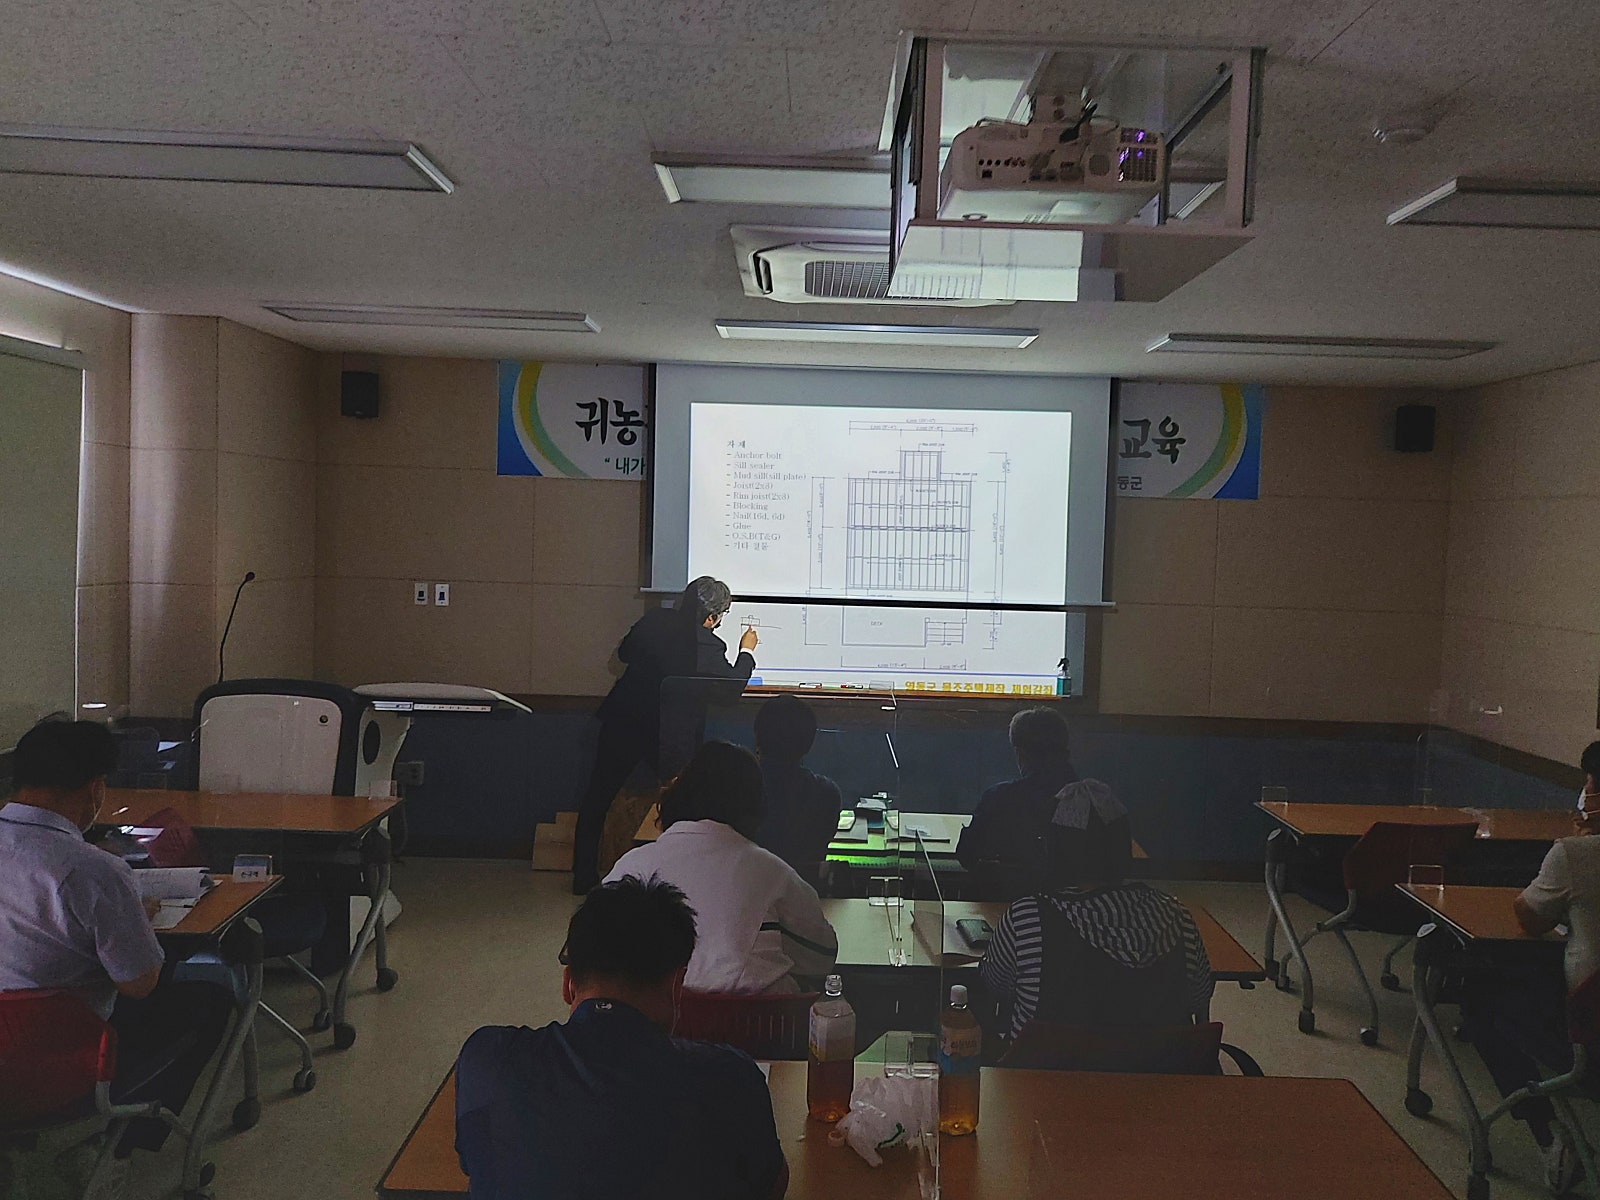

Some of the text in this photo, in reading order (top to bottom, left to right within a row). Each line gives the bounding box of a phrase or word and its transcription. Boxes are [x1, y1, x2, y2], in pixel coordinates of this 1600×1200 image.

[575, 397, 644, 446] 귀농
[1119, 415, 1186, 464] 교육
[734, 451, 782, 460] Anchor bolt
[749, 462, 775, 470] sealer
[733, 471, 751, 479] Mud
[733, 492, 749, 500] Rim
[733, 502, 768, 511] Blocking
[732, 522, 752, 530] Glue
